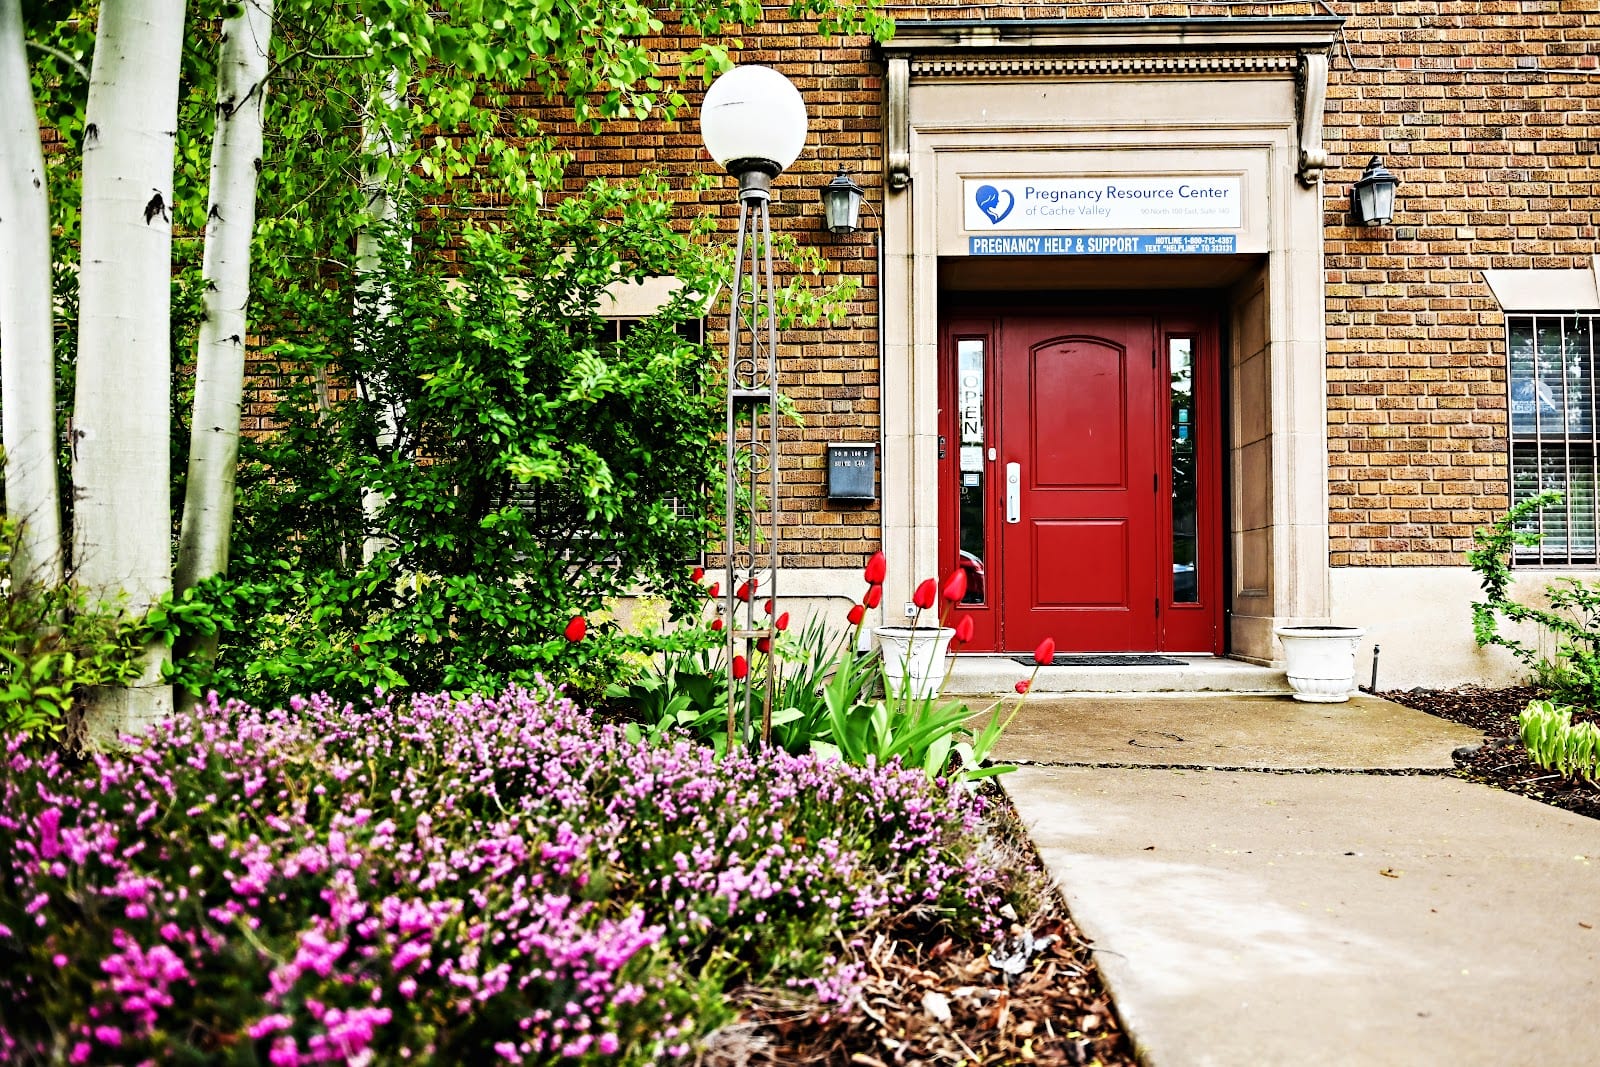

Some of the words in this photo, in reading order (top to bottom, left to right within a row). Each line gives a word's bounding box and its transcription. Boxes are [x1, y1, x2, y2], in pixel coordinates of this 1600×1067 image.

[1025, 186, 1103, 203] Pregnancy
[1106, 185, 1174, 199] Resource
[1178, 184, 1229, 198] Center
[1025, 206, 1037, 216] of
[1040, 205, 1075, 216] Cache
[1079, 204, 1112, 218] Valley
[1150, 207, 1170, 215] North
[1200, 207, 1217, 215] Suite
[973, 238, 1041, 254] PREGNANCY
[1044, 237, 1073, 253] HELP
[1075, 238, 1085, 253] &
[1087, 237, 1140, 253] SUPPORT
[1155, 236, 1183, 245] HOTLINE
[1145, 244, 1161, 253] TEXT
[1201, 244, 1210, 253] TO
[963, 375, 979, 436] OPEN
